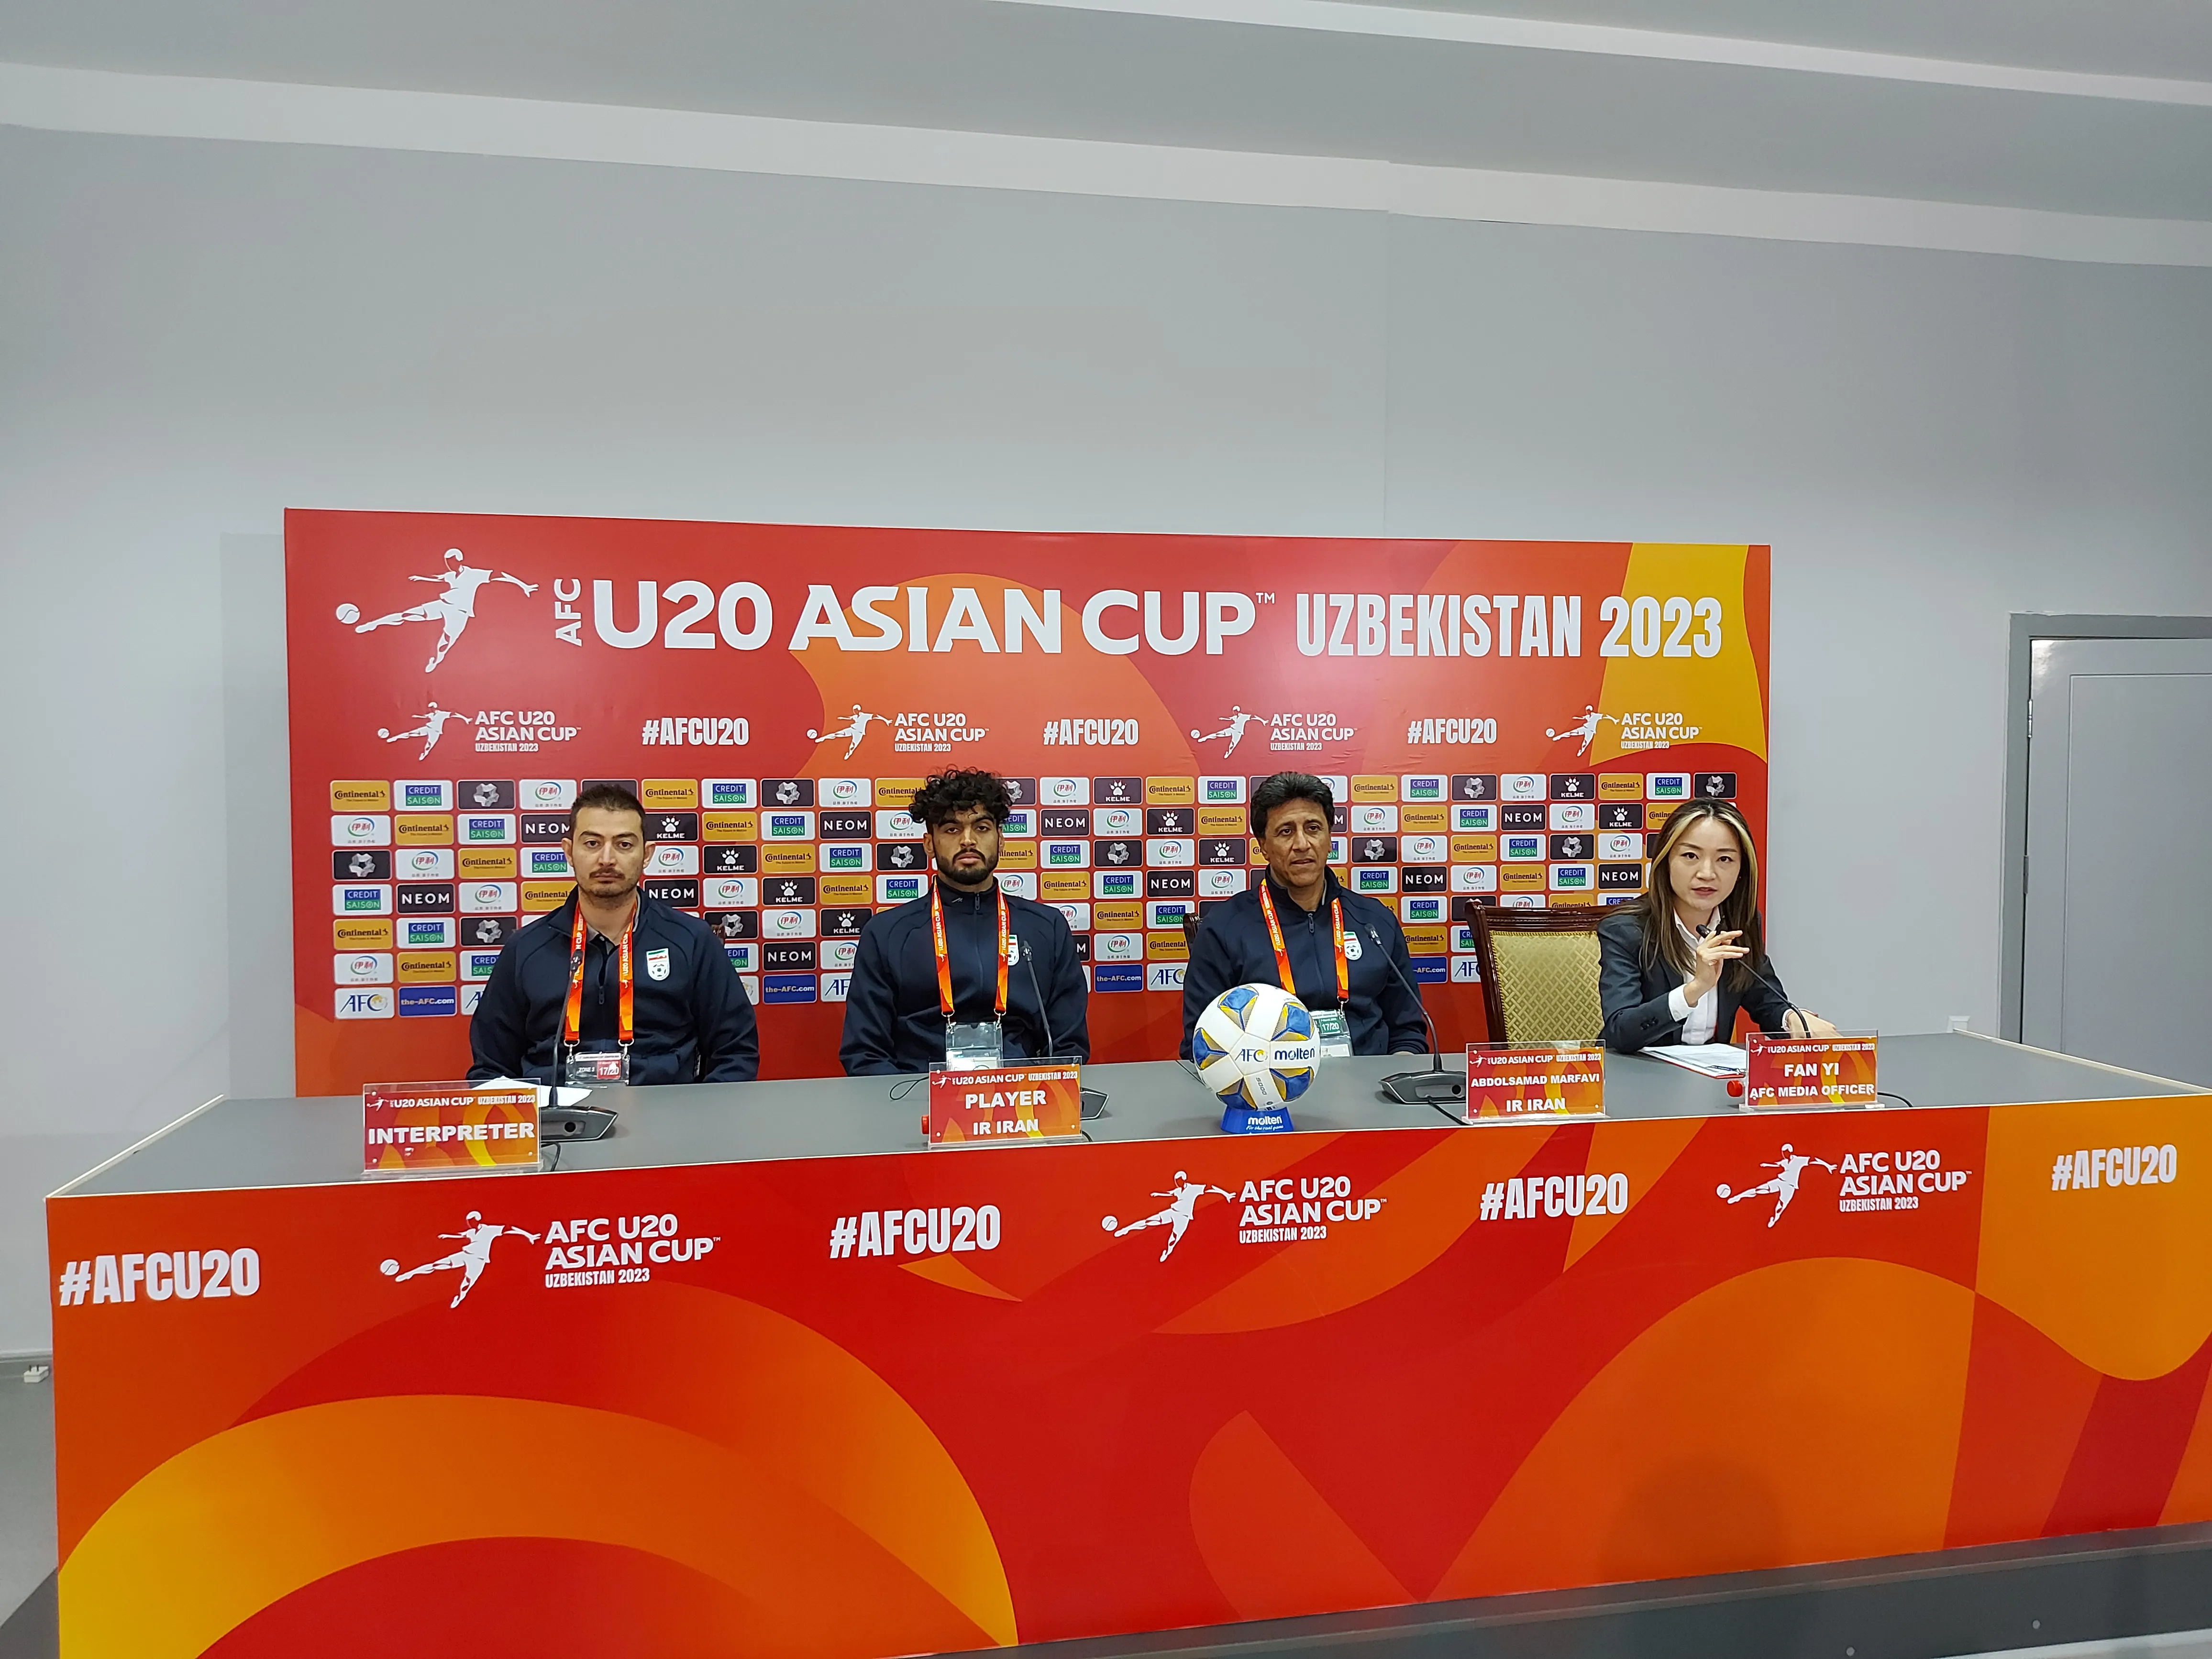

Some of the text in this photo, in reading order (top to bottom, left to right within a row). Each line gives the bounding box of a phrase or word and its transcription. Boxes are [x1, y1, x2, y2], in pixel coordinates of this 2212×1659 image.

[554, 579, 582, 646] AFC
[594, 580, 772, 650] U20
[788, 585, 1061, 653] ASIAN
[1297, 594, 1581, 656] UZBEKISTAN
[1600, 596, 1721, 657] 2023
[475, 711, 554, 725] AFC U20
[895, 713, 965, 726] AFC U20
[1271, 714, 1336, 726] AFC U20
[1622, 713, 1682, 725] AFC U20
[476, 727, 534, 741] ASIAN
[642, 718, 749, 745] #AFCU20
[895, 729, 947, 741] ASIAN
[1044, 719, 1138, 745] #AFCU20
[1271, 728, 1318, 740] ASIAN
[1408, 719, 1496, 743] #AFCU20
[1621, 727, 1666, 739] ASIAN
[476, 743, 538, 752] UZBEKISTAN 2023
[895, 743, 932, 752] UZBEKISTAN
[334, 791, 379, 799] Continental
[408, 785, 438, 794] CREDIT
[408, 796, 442, 805] SAISON
[1045, 818, 1085, 828] NEOM
[1201, 816, 1236, 824] Continental
[1505, 813, 1541, 822] NEOM
[706, 821, 747, 830] Continental
[824, 820, 866, 830] NEOM
[765, 853, 807, 862] Continental
[1602, 872, 1638, 881] NEOM
[888, 879, 915, 887] CREDIT
[346, 889, 377, 898] CREDIT
[888, 890, 918, 898] SAISON
[1105, 886, 1133, 894] SAISON
[347, 900, 381, 908] SAISON
[402, 893, 449, 904] NEOM
[1412, 900, 1436, 908] CREDIT
[1097, 911, 1134, 919] Continental
[768, 951, 811, 962] NEOM
[1274, 1048, 1315, 1060] molten
[1508, 1056, 1534, 1064] ASIAN
[1785, 1063, 1838, 1076] FAN YI
[975, 1075, 1003, 1084] ASIAN
[1063, 1071, 1077, 1079] 2023
[1471, 1073, 1599, 1087] ABDOLSAMAD MARFAVI
[1750, 1084, 1876, 1098] AFC MEDIA OFFICER
[393, 1099, 415, 1107] U20
[416, 1098, 449, 1106] ASIAN
[518, 1094, 537, 1103] 2023
[966, 1091, 1046, 1109] PLAYER
[1506, 1098, 1565, 1112] IR IRAN
[1248, 1116, 1282, 1125] molten
[973, 1119, 1038, 1135] IR IRAN
[369, 1123, 535, 1144] INTERPRETER
[1840, 1150, 1940, 1173] AFC U20
[2052, 1144, 2177, 1190] #AFCU20
[1239, 1176, 1350, 1202] AFC U20
[1840, 1174, 1913, 1196] ASIAN
[1481, 1173, 1627, 1220] #AFCU20
[1840, 1196, 1918, 1212] UZBEKISTAN 2023
[1239, 1200, 1320, 1227] ASIAN
[545, 1214, 677, 1245] AFC U20
[830, 1205, 1000, 1258] #AFCU20
[1239, 1226, 1326, 1243] UZBEKISTAN 2023
[545, 1241, 642, 1270] ASIAN
[59, 1248, 259, 1305] #AFCU20
[546, 1268, 649, 1288] UZBEKISTAN 2023
